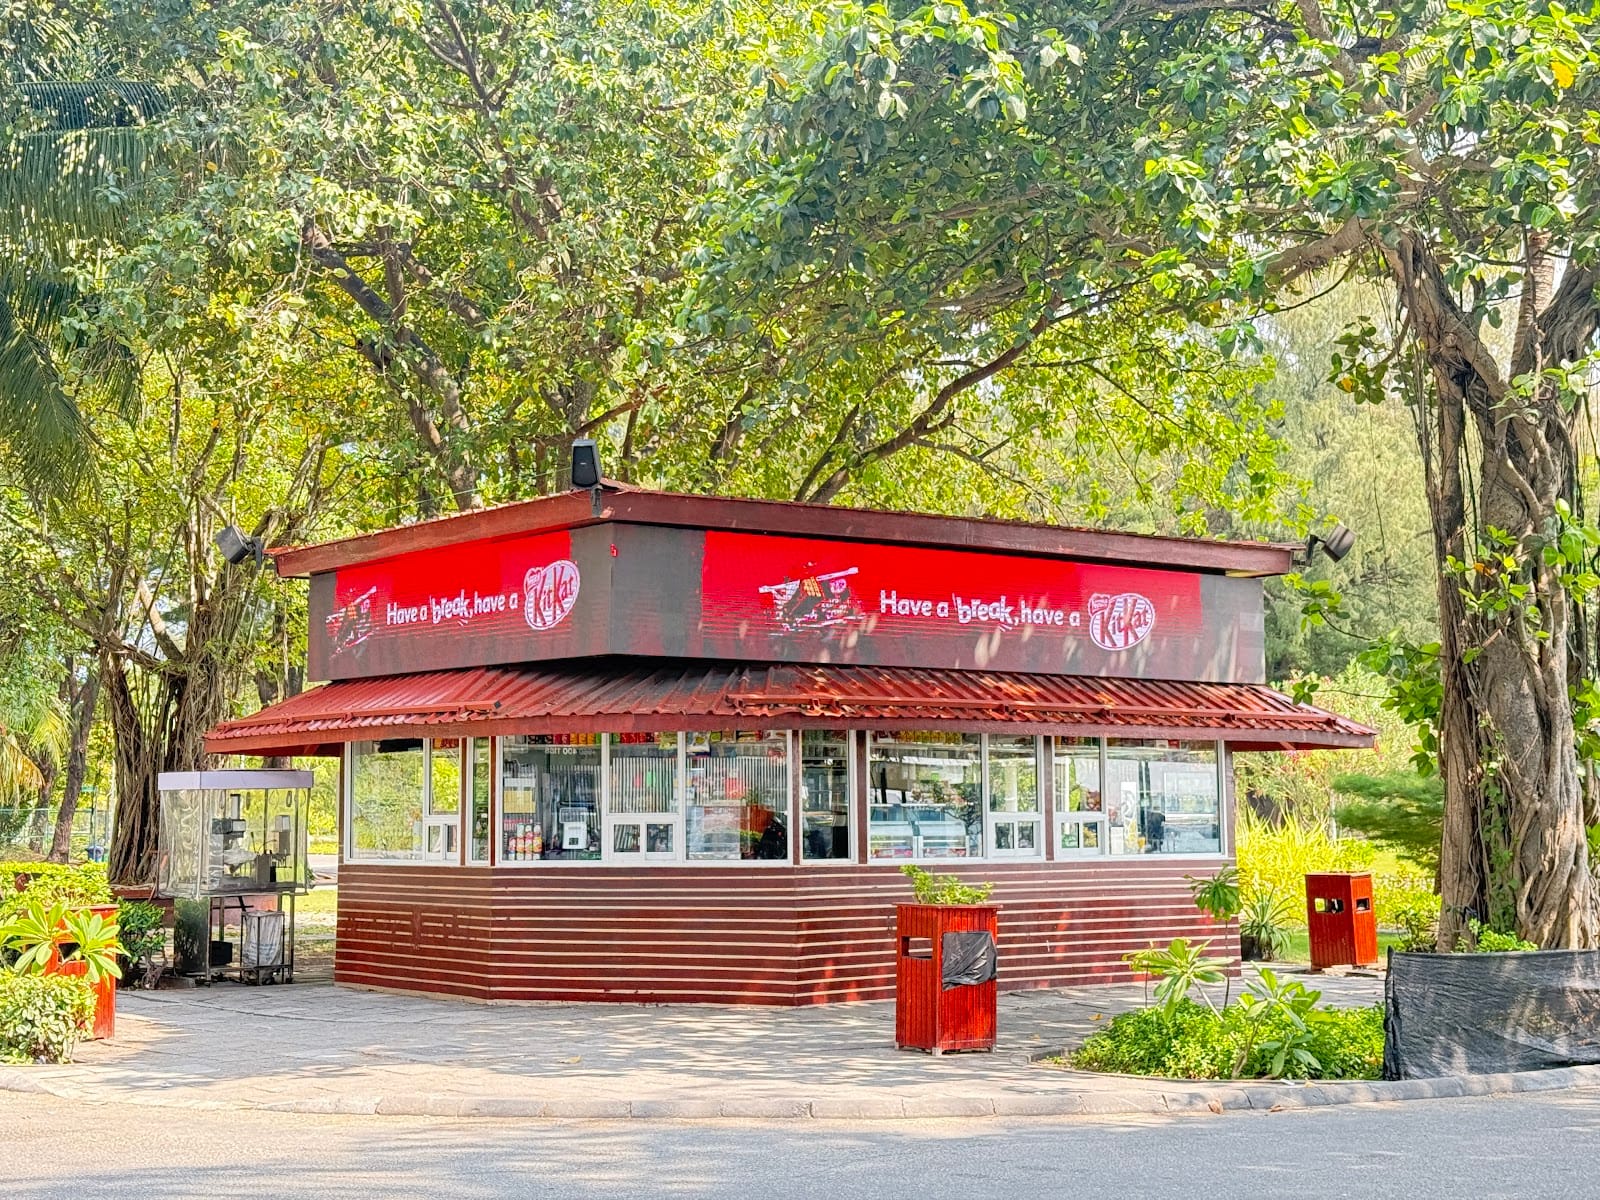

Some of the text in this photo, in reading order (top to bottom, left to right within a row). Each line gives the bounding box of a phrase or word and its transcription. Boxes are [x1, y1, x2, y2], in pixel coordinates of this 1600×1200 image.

[386, 602, 418, 626] Have
[419, 605, 428, 622] a
[474, 591, 506, 614] have
[508, 592, 519, 610] a
[532, 565, 575, 626] KitKat
[880, 589, 932, 616] Have
[936, 601, 949, 618] a
[1020, 600, 1064, 626] have
[1068, 610, 1081, 627] a
[1098, 597, 1149, 649] KitKat
